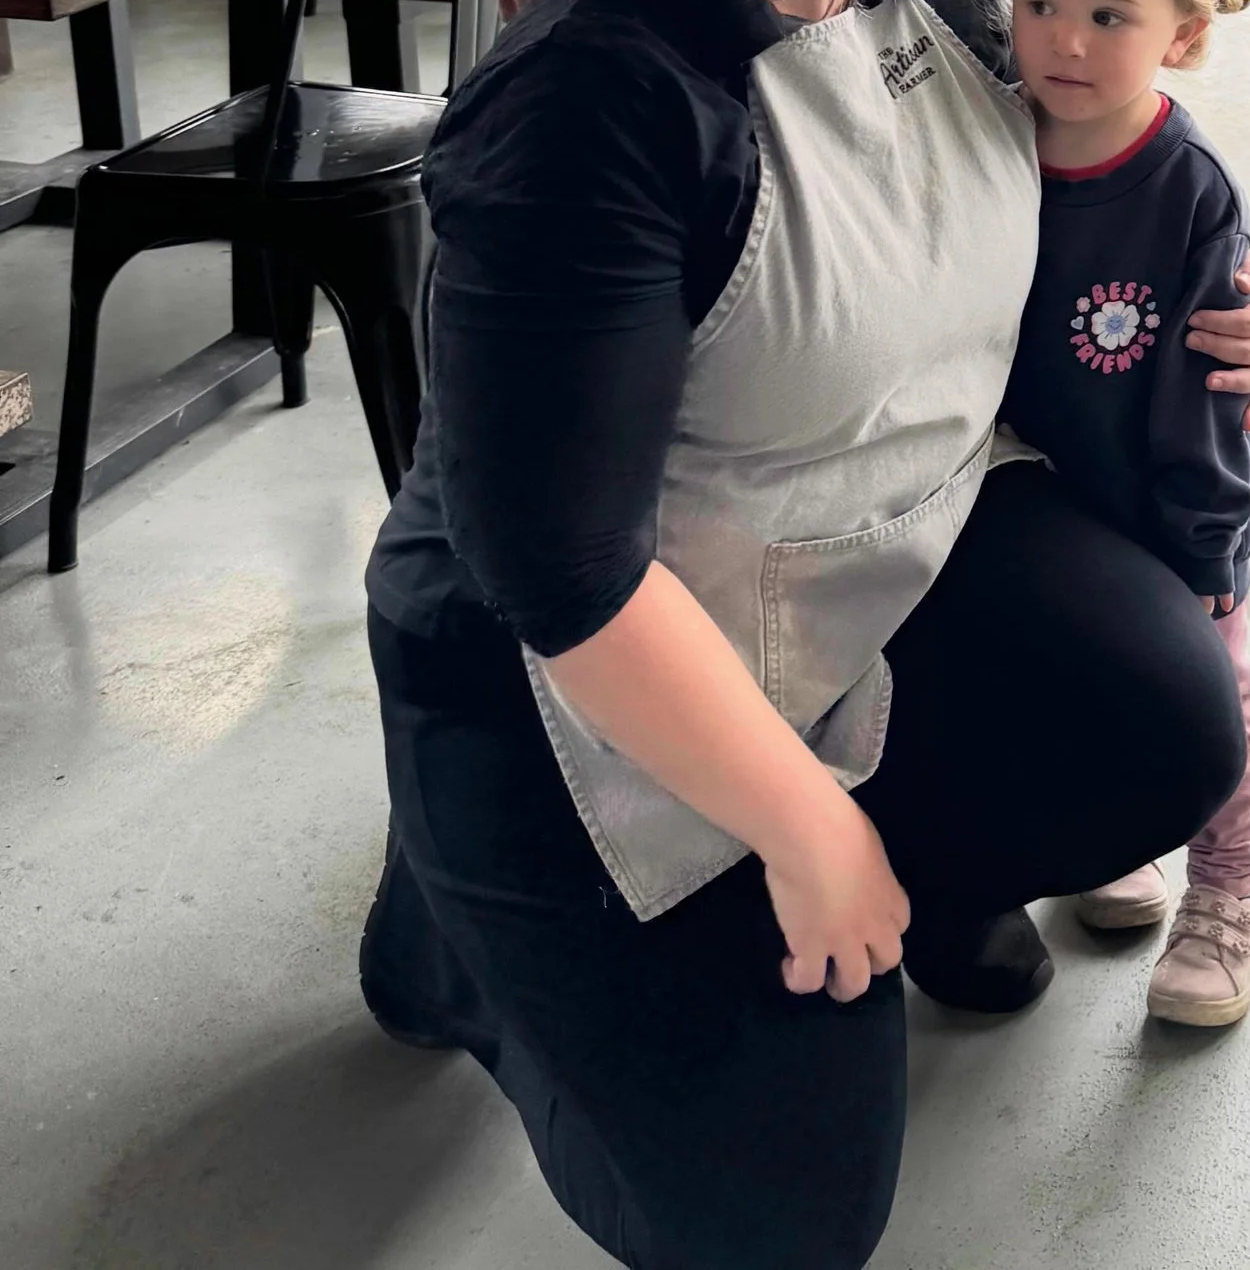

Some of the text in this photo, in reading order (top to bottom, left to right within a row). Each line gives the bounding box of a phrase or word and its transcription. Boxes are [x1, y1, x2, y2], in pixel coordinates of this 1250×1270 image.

[879, 35, 935, 100] Artisan
[1091, 281, 1152, 305] BEST
[1070, 332, 1155, 374] FRIENDS
